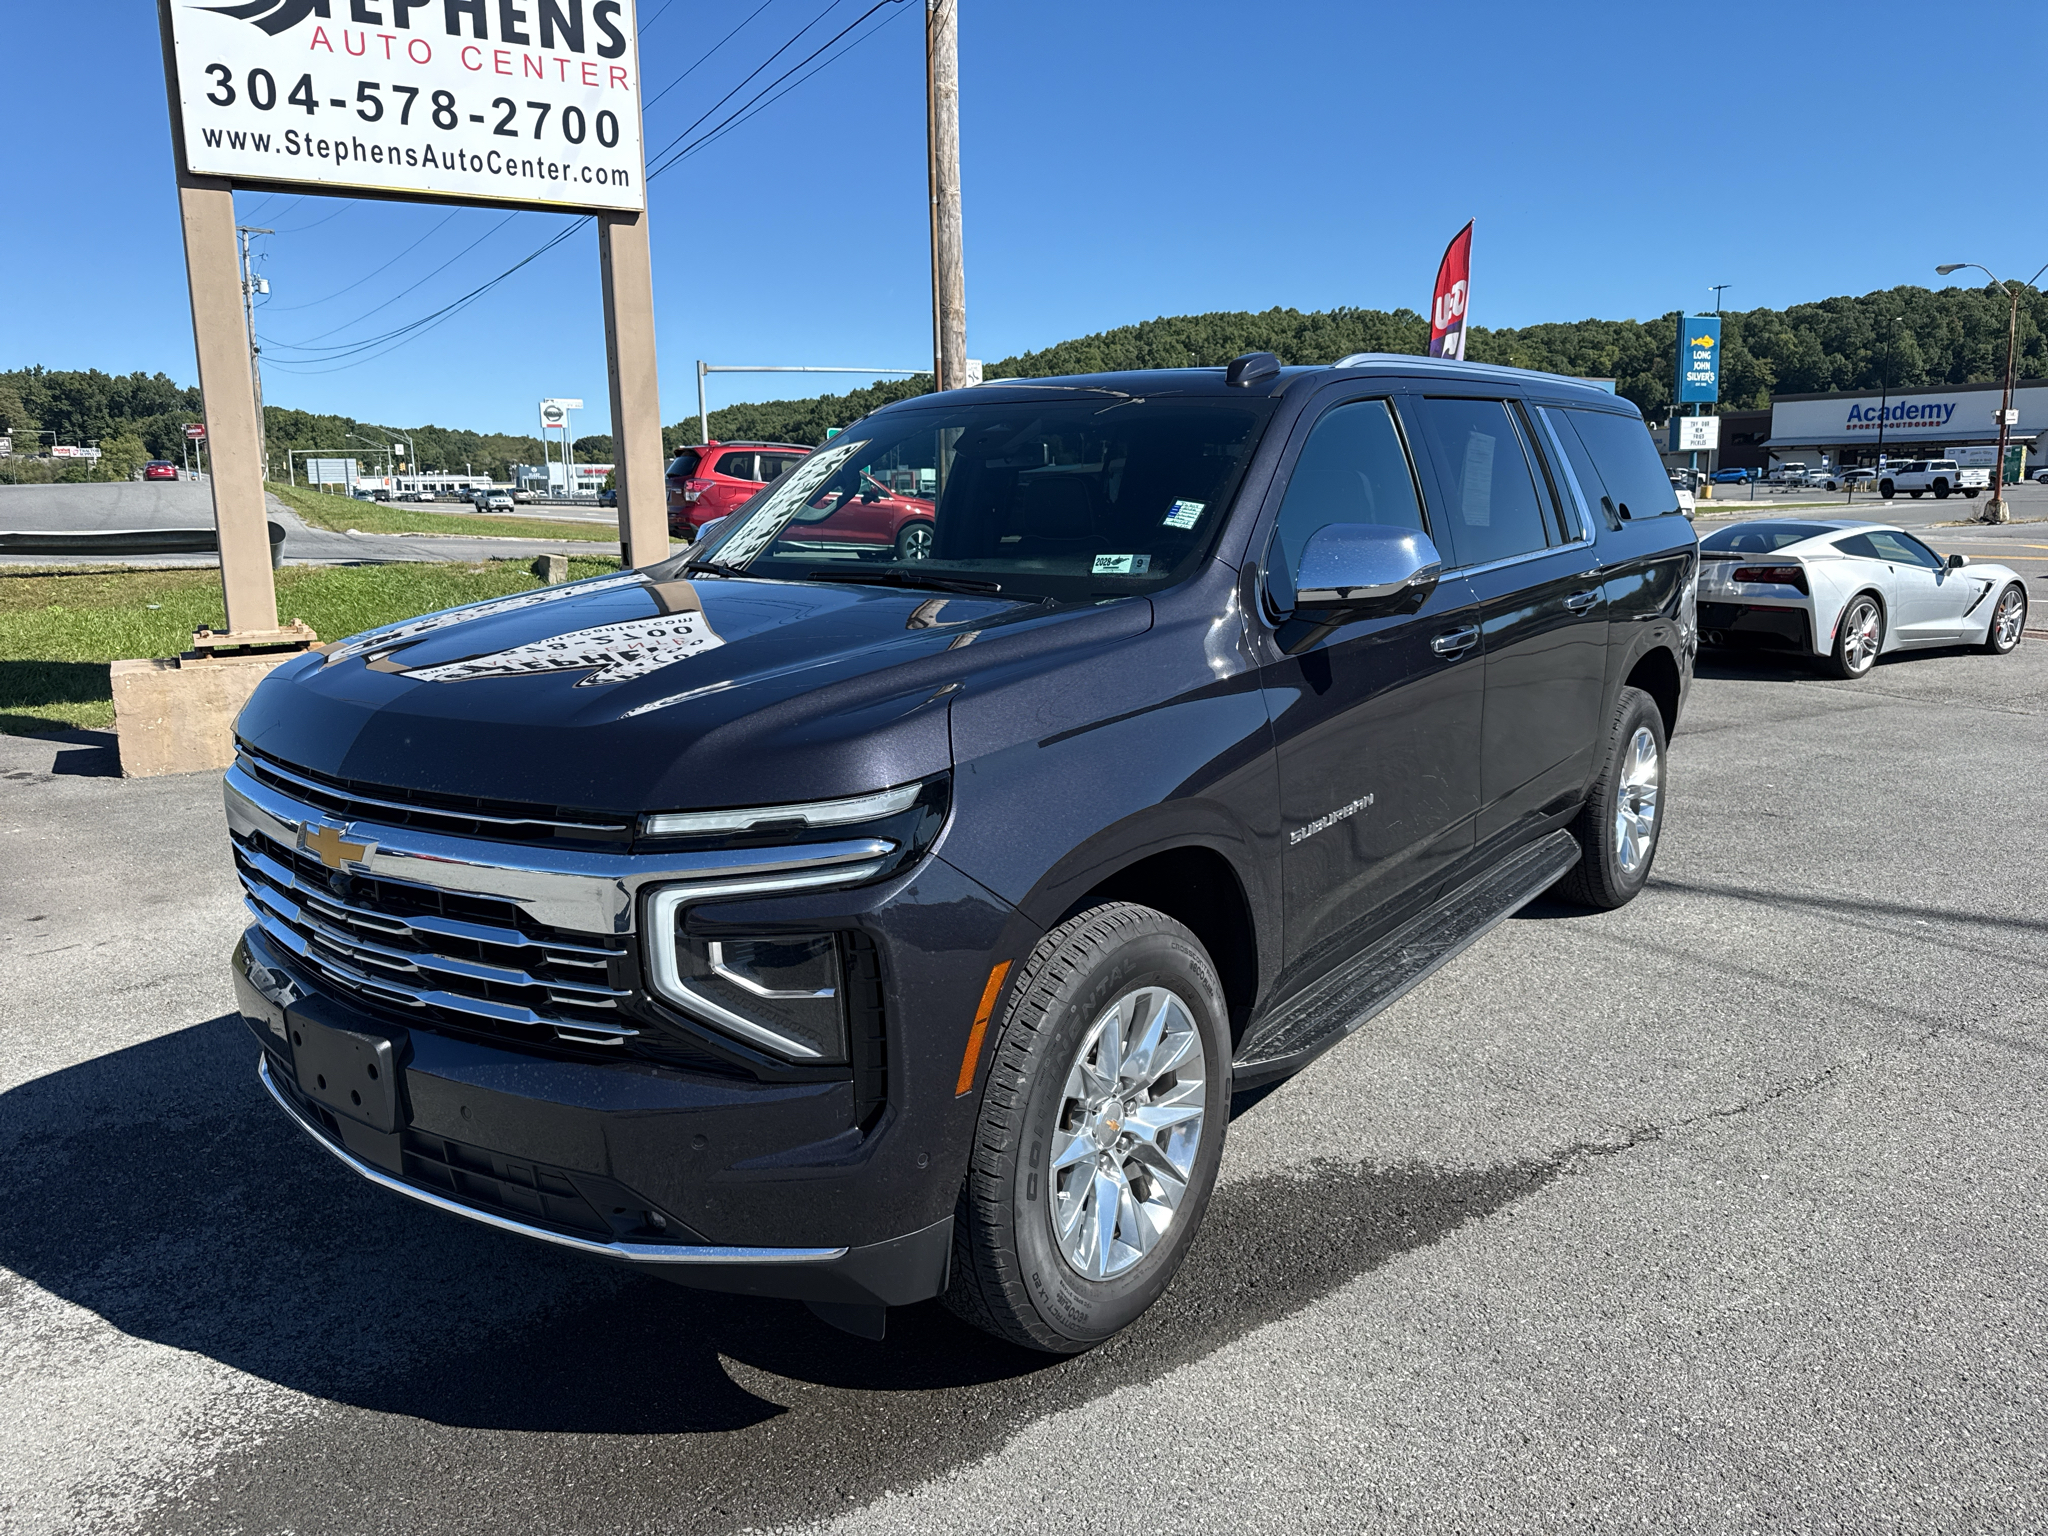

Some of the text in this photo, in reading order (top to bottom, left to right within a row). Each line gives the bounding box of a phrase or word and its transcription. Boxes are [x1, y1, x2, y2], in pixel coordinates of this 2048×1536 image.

[262, 0, 627, 59] PHENS
[310, 26, 630, 91] AUTO CENTER
[204, 63, 620, 148] 304-578-2700
[201, 128, 630, 188] www.StephensAutoCenter.com
[1693, 350, 1711, 360] LONG
[1693, 361, 1711, 371] JOHN
[1686, 371, 1715, 384] SILVER'S
[1847, 401, 1957, 425] Academy
[1136, 558, 1144, 568] 9
[1289, 792, 1374, 846] SUBURBAN
